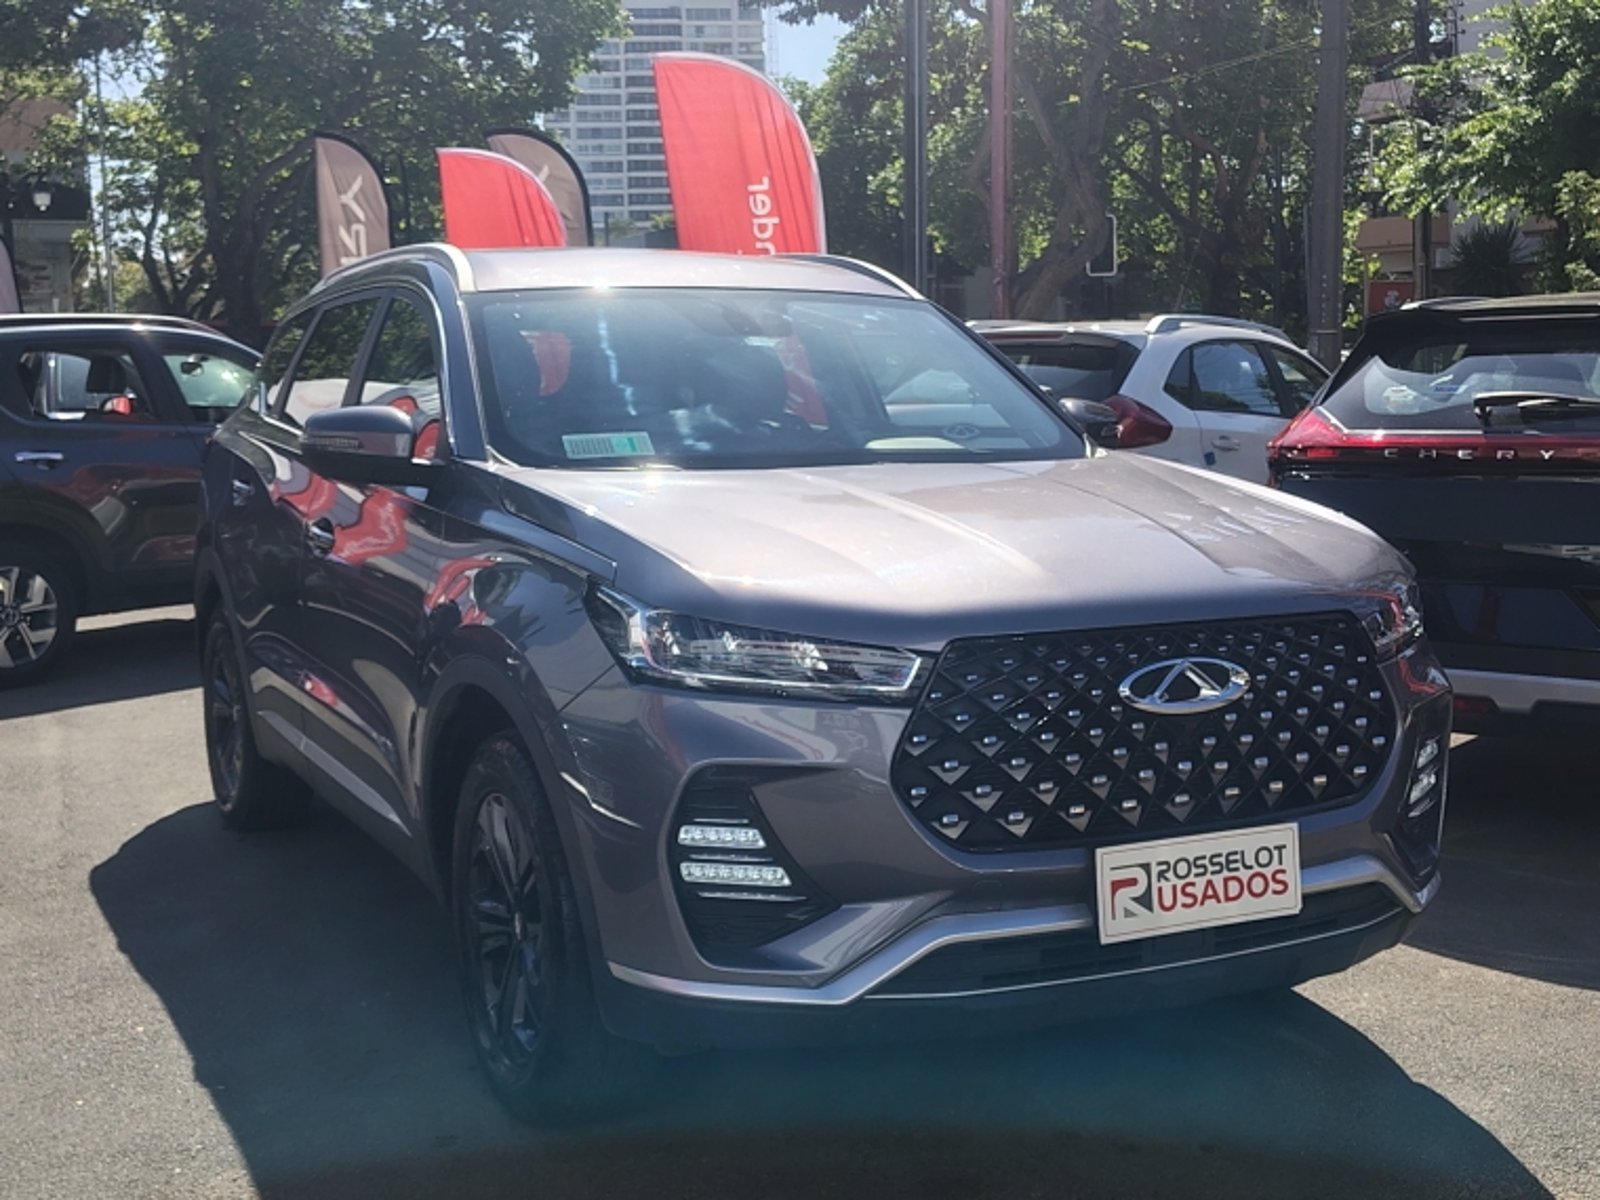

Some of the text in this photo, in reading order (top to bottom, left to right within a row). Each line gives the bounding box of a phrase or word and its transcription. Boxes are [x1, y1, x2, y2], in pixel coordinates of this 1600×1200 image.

[1384, 448, 1555, 460] CHERY
[1156, 844, 1288, 883] ROSSELOT
[1157, 868, 1289, 913] USADOS
